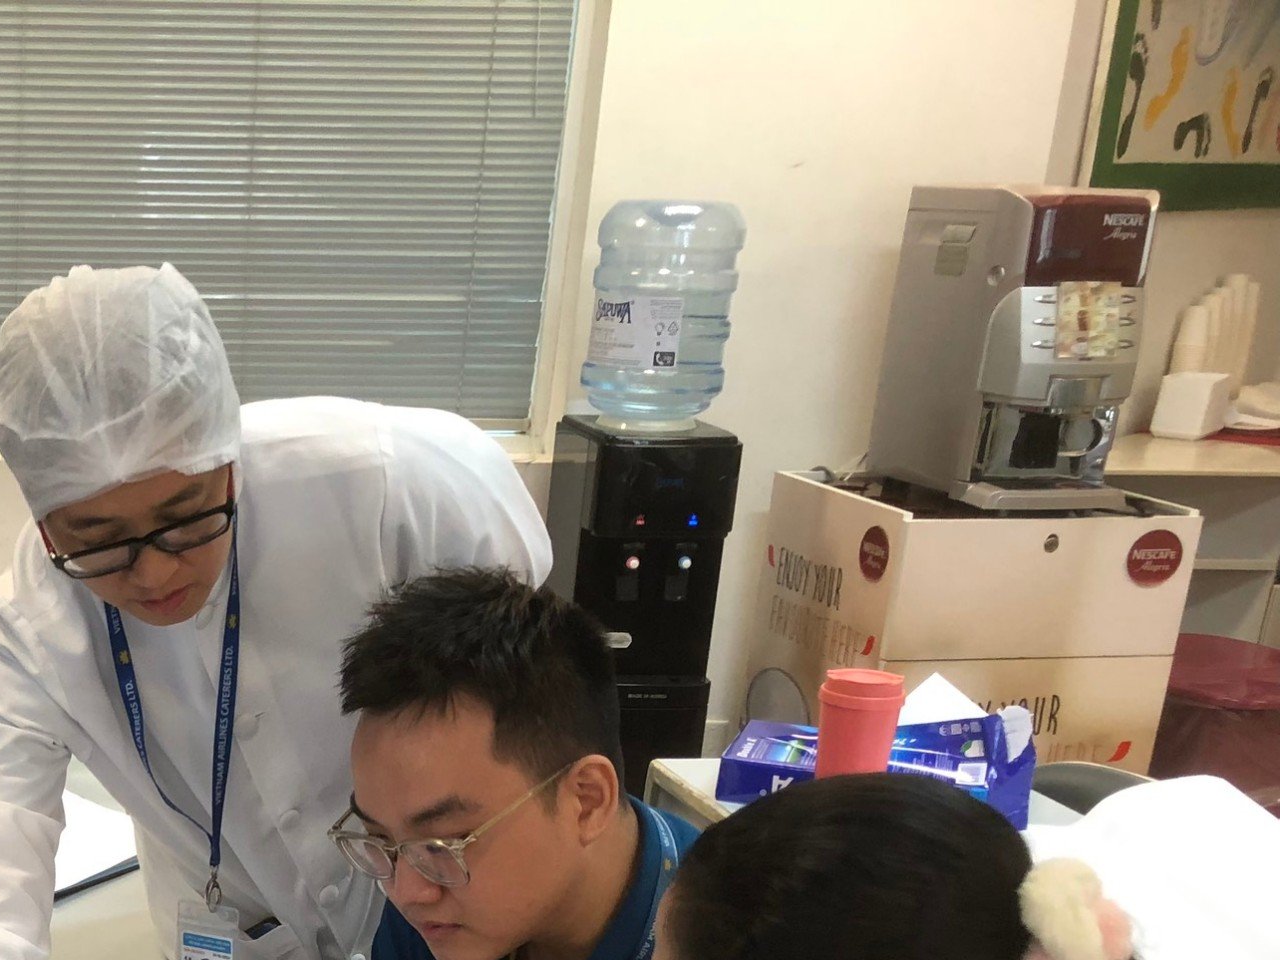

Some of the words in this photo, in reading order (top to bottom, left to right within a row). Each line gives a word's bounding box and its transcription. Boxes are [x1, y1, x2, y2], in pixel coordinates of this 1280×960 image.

[776, 547, 811, 595] ENJOY
[812, 565, 843, 610] YOUR
[225, 645, 234, 666] LTD.
[125, 679, 136, 701] LTD.
[221, 667, 233, 716] CATERERS
[130, 701, 144, 749] CATERERS
